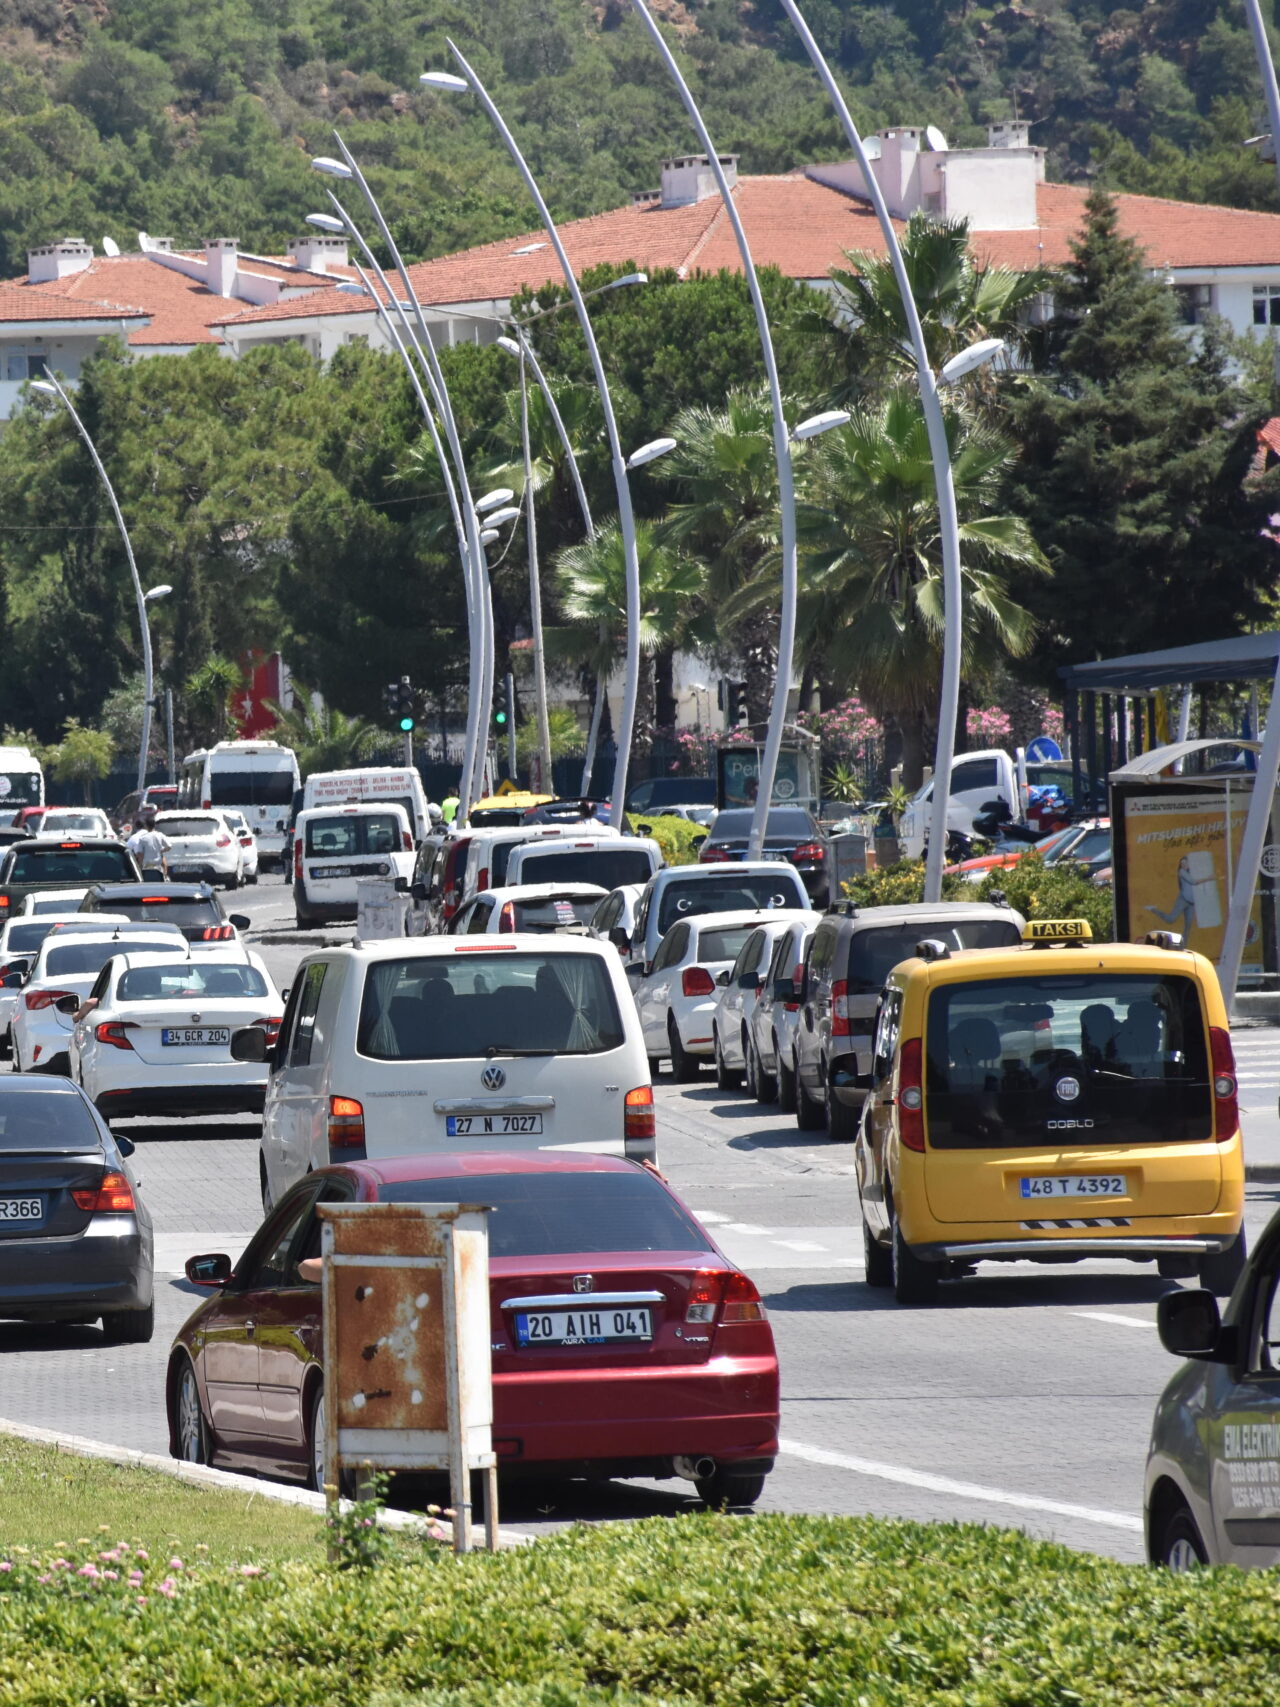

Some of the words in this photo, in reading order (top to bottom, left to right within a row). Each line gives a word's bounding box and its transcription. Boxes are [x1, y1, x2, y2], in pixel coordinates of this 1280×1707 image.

[1136, 823, 1206, 844] MITSUBISHI
[1034, 923, 1081, 936] TAKSİ
[169, 1030, 181, 1041] 34
[184, 1029, 203, 1041] GCR
[208, 1029, 227, 1041] 204
[456, 1118, 473, 1133] 27
[483, 1117, 493, 1133] N
[502, 1116, 537, 1132] 7027
[1047, 1119, 1094, 1129] DOBLO
[1031, 1180, 1053, 1194] 48
[1058, 1179, 1069, 1194] T
[1076, 1178, 1122, 1193] 4392
[529, 1316, 553, 1338] 20
[566, 1313, 601, 1336] AIH
[613, 1311, 647, 1334] 041
[587, 1336, 605, 1344] CAR
